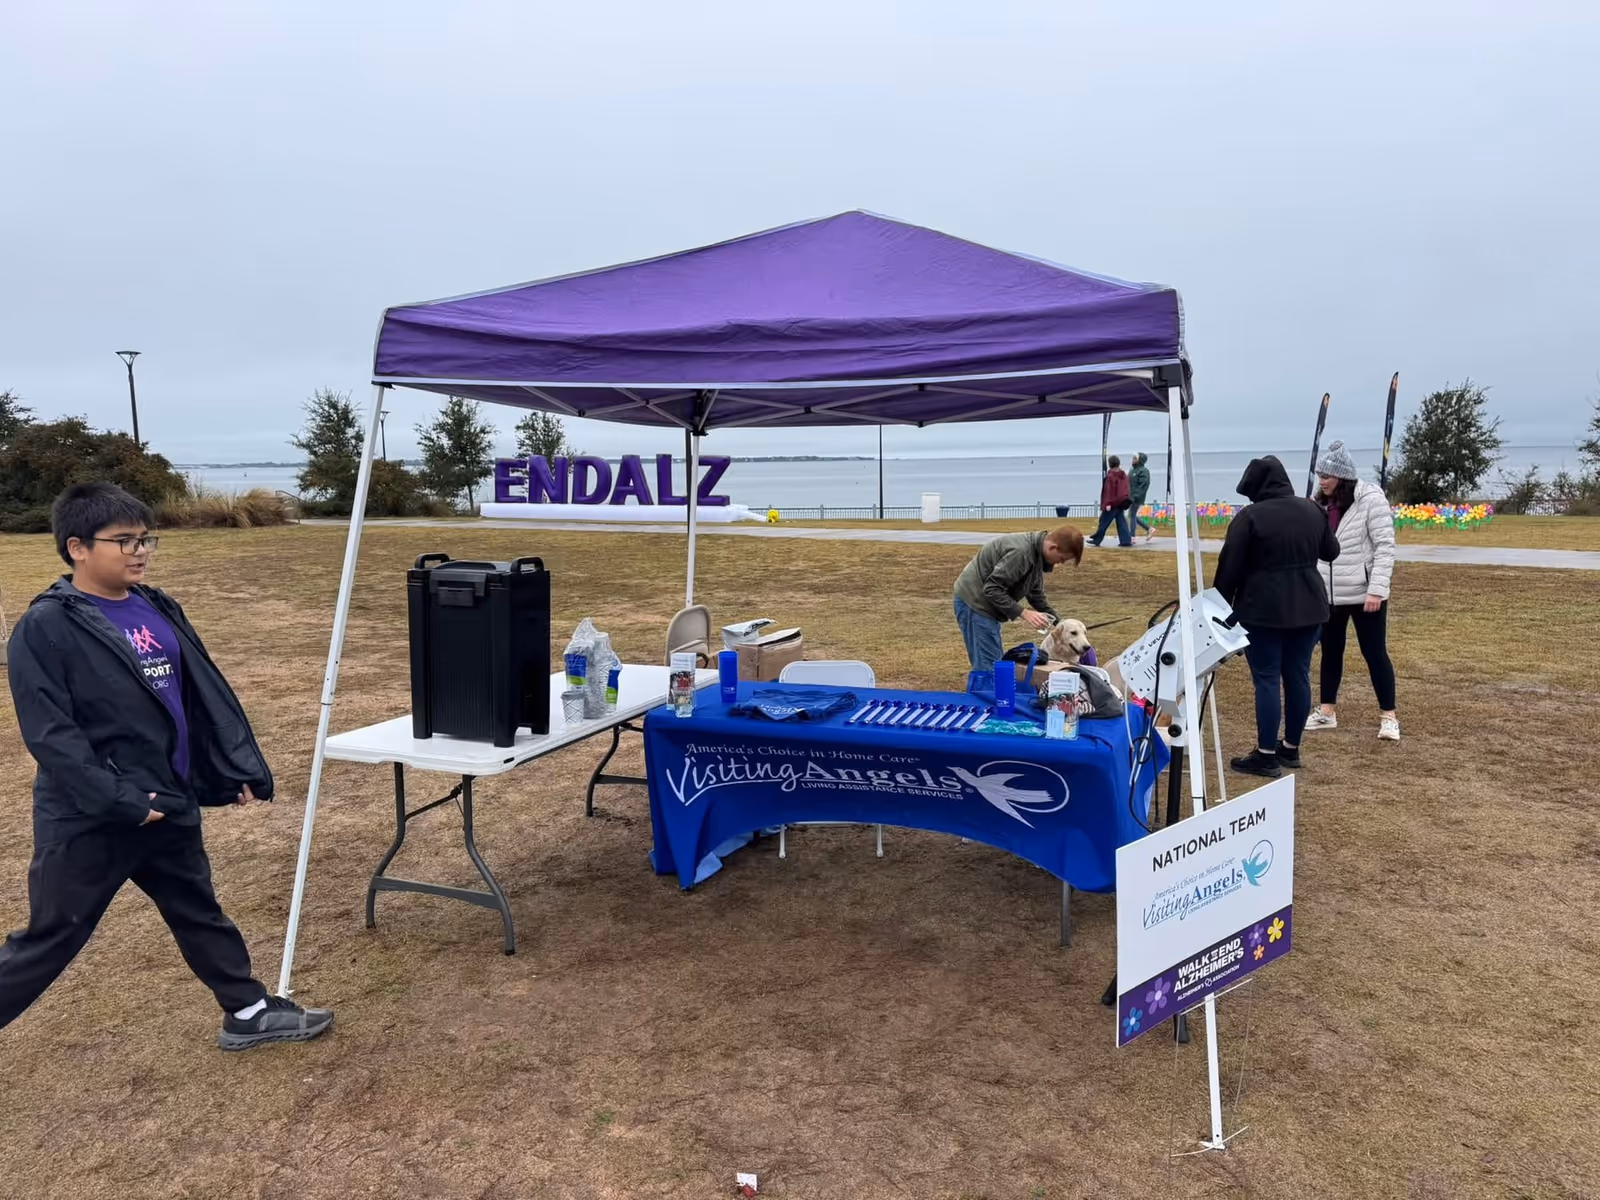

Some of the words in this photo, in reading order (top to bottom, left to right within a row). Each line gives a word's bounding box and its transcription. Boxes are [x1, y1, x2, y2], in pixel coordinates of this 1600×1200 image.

[685, 743, 754, 756] America's
[757, 745, 805, 756] Choice
[810, 749, 824, 758] in
[827, 750, 875, 761] Home
[801, 782, 836, 790] LIVING
[838, 784, 906, 794] ASSISTANCE
[907, 788, 964, 800] SERVICES
[1152, 827, 1225, 872] NATIONAL
[1229, 807, 1266, 836] TEAM
[1173, 947, 1244, 993] ALZHEIMER'S
[1178, 953, 1210, 979] WALK
[1219, 938, 1241, 957] END
